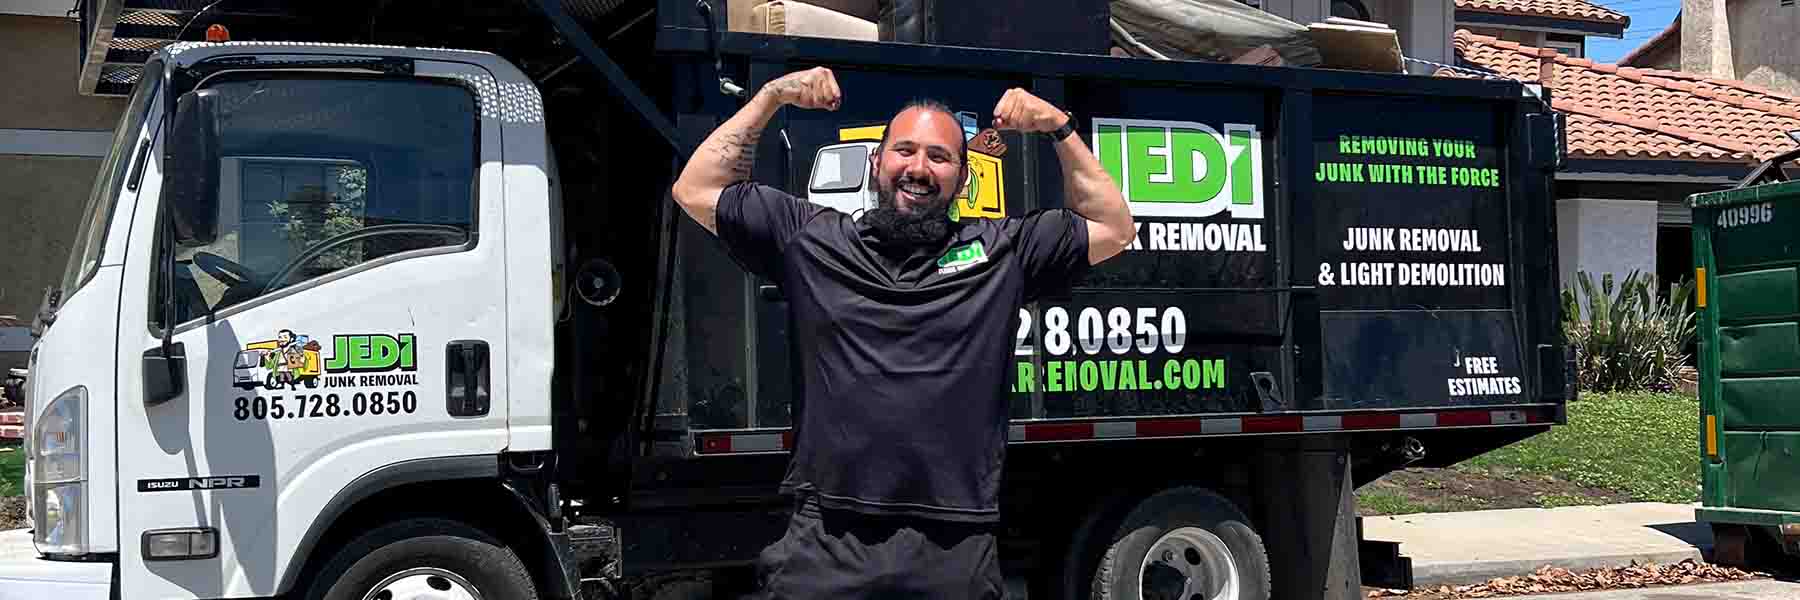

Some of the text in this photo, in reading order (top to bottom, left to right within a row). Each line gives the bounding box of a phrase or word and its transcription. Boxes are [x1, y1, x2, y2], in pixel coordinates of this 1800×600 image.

[1339, 135, 1476, 159] REMOVING YOUR
[1315, 163, 1500, 187] JUNK WITH THE FORCE
[1717, 202, 1773, 228] 40996
[1149, 222, 1267, 251] REMOVAL
[1343, 227, 1481, 252] JUNK REMOVAL
[1318, 262, 1505, 286] & LIGHT DEMOLITION
[324, 333, 417, 373] JEDI
[1464, 356, 1499, 375] FREE
[323, 374, 419, 388] JUNK REMOVAL
[1447, 376, 1522, 396] ESTIMATES
[234, 390, 417, 421] 805.728.0850
[147, 477, 245, 489] ISUZU NPR
